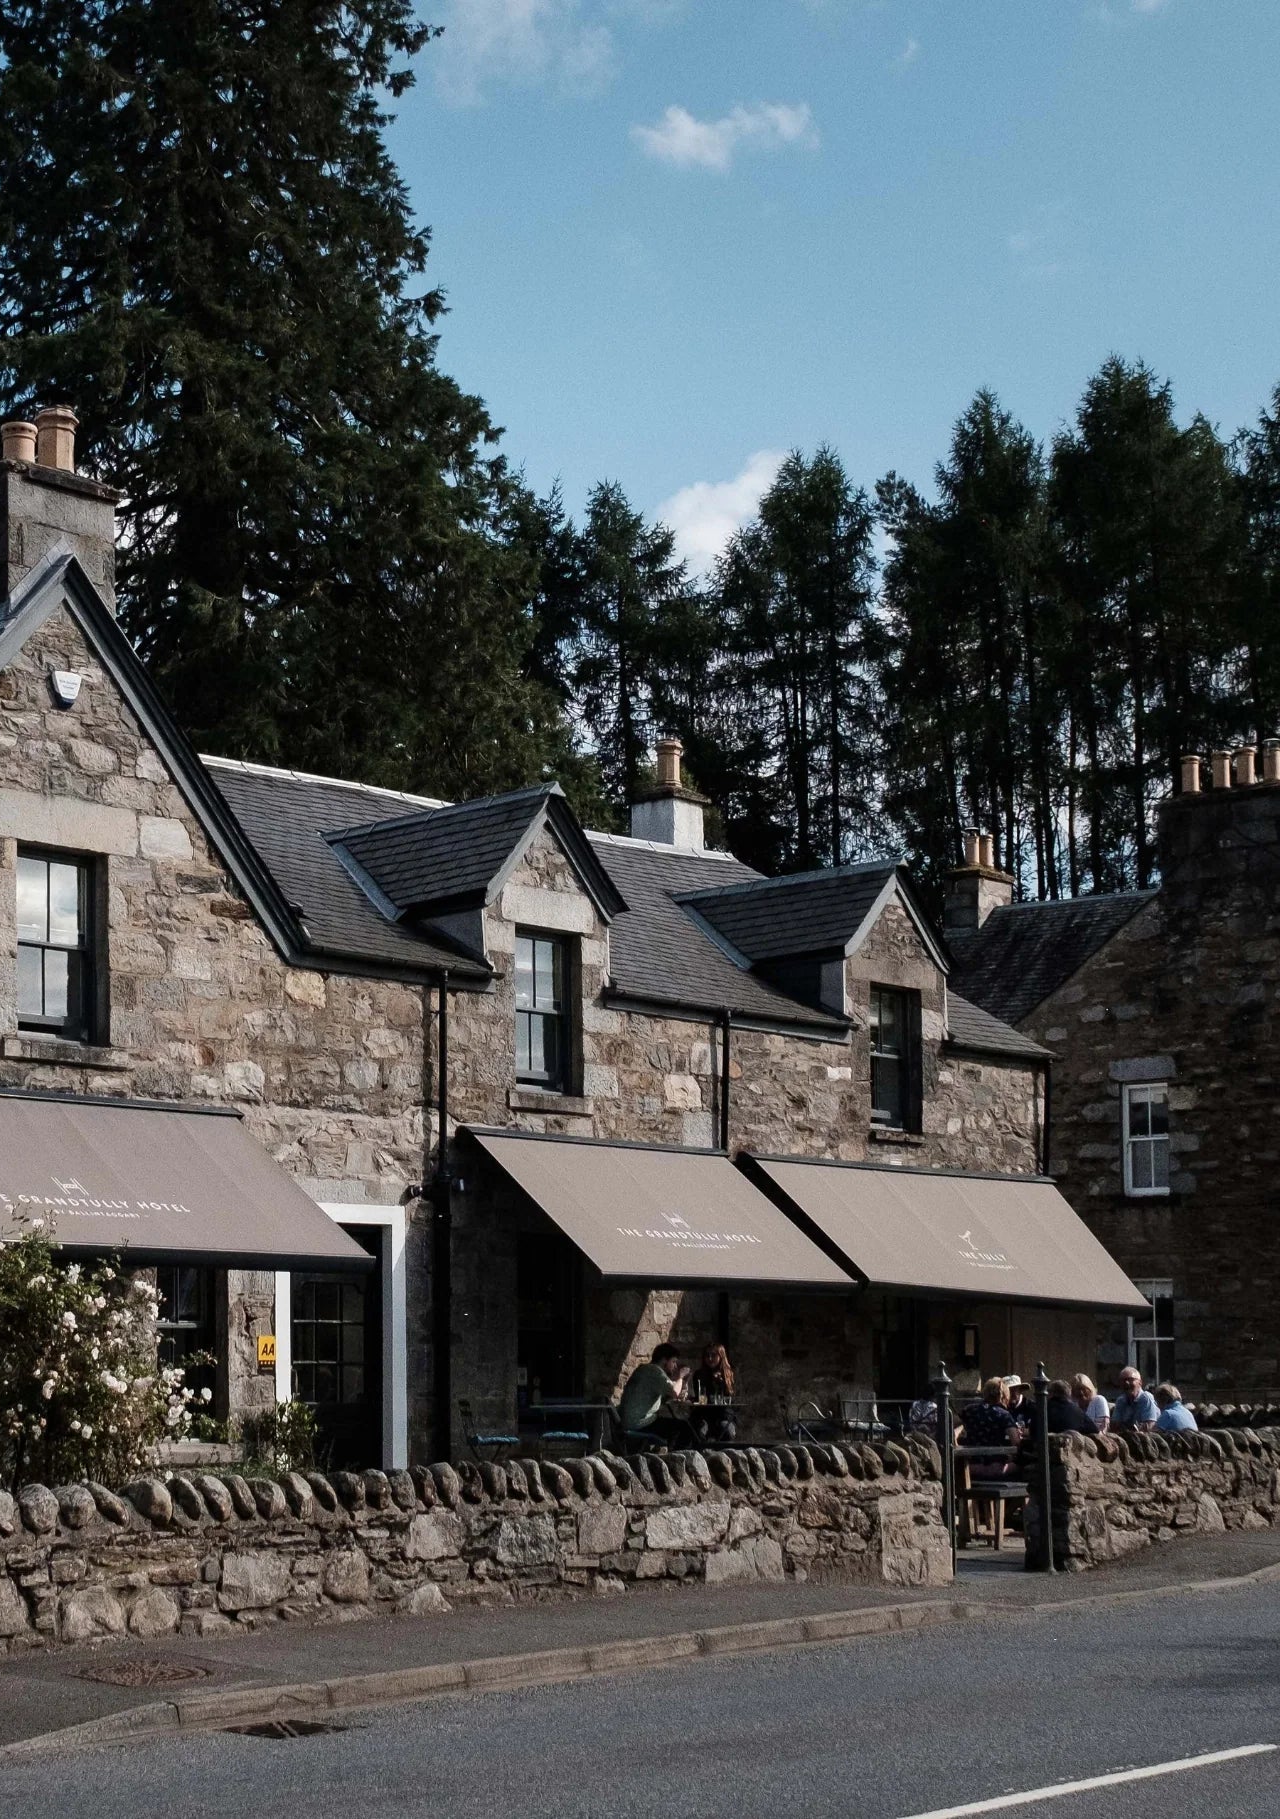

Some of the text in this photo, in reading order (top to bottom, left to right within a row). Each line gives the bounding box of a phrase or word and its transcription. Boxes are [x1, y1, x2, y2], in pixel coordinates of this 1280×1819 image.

[18, 1194, 130, 1209] GRANDTULLY
[136, 1201, 191, 1213] HOTEL
[616, 1227, 762, 1243] THE GRANDTULLY HOTEL
[261, 1343, 275, 1356] AA
